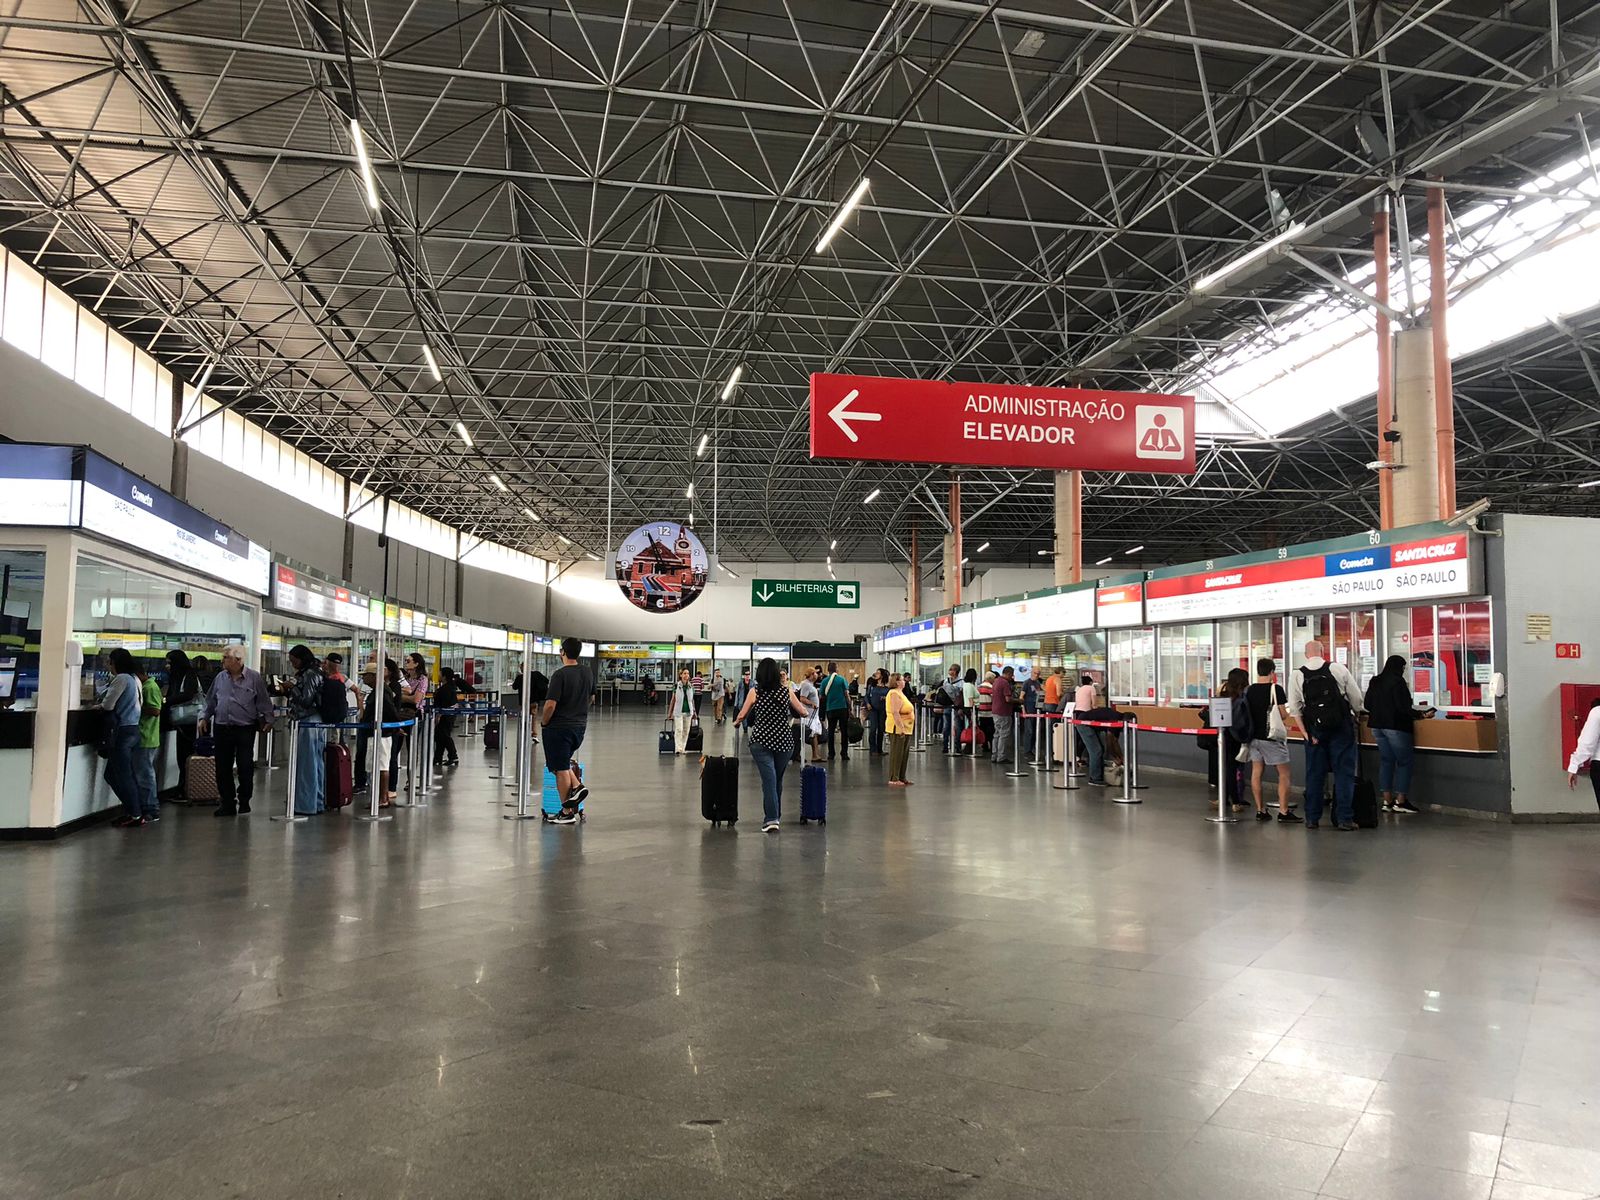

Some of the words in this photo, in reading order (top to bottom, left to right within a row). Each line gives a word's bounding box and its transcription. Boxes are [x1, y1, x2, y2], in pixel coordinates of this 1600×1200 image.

[963, 394, 1126, 424] ADMINISTRAÇÃO
[963, 421, 1076, 445] ELEVADOR
[657, 526, 671, 536] 12
[1369, 532, 1381, 545] 60
[1278, 547, 1287, 559] 59
[1394, 547, 1428, 562] SANTA
[1428, 542, 1456, 558] CRUZ
[620, 560, 629, 569] 9
[695, 564, 703, 574] 3
[1340, 556, 1374, 570] Cometa
[1396, 572, 1418, 588] SÃO
[1420, 569, 1457, 584] PAULO
[775, 583, 834, 594] BILHETERIAS
[1332, 579, 1351, 596] SÃO
[1353, 578, 1384, 593] PAULO
[656, 599, 665, 608] 6
[1570, 645, 1579, 657] H
